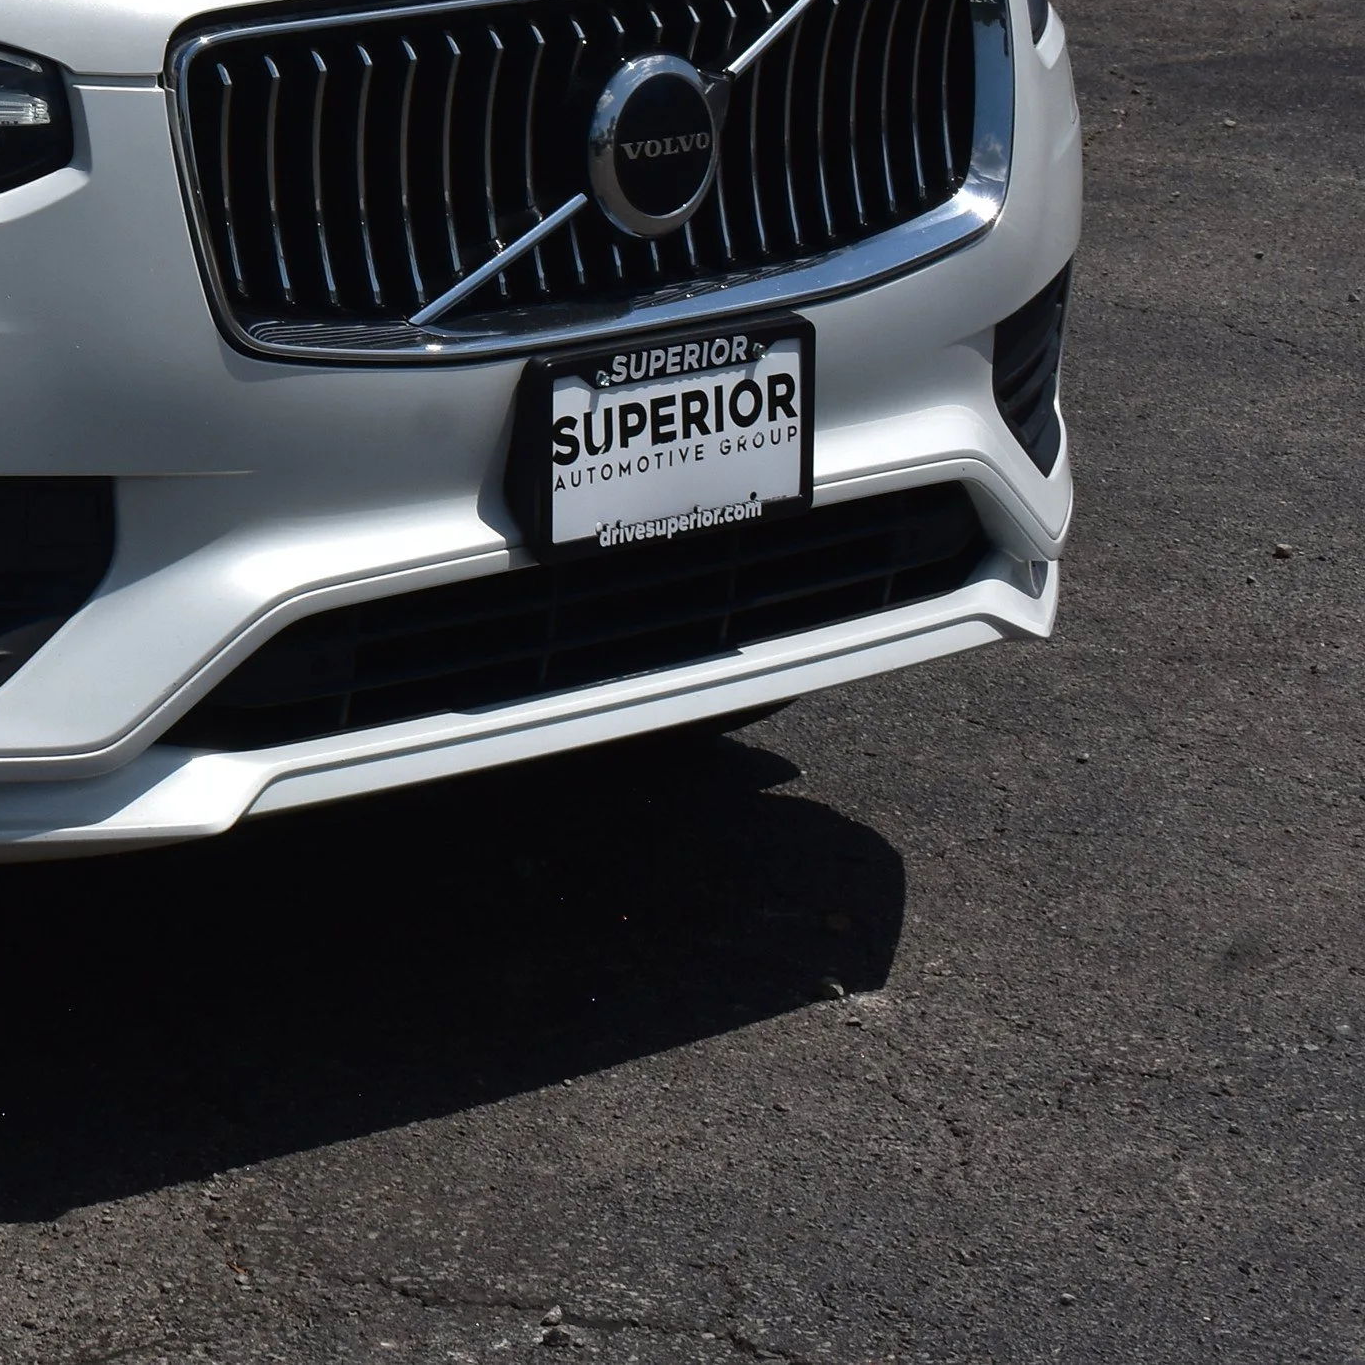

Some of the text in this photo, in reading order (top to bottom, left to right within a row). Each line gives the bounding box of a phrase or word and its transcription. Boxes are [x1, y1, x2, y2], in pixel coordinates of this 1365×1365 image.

[620, 132, 710, 160] VOLVO
[611, 335, 748, 383] SUPERIOR
[552, 372, 798, 466] SUPERIOR
[554, 425, 798, 492] AUTOMOTIVE GROUP
[598, 498, 762, 547] drivesuperior.com
